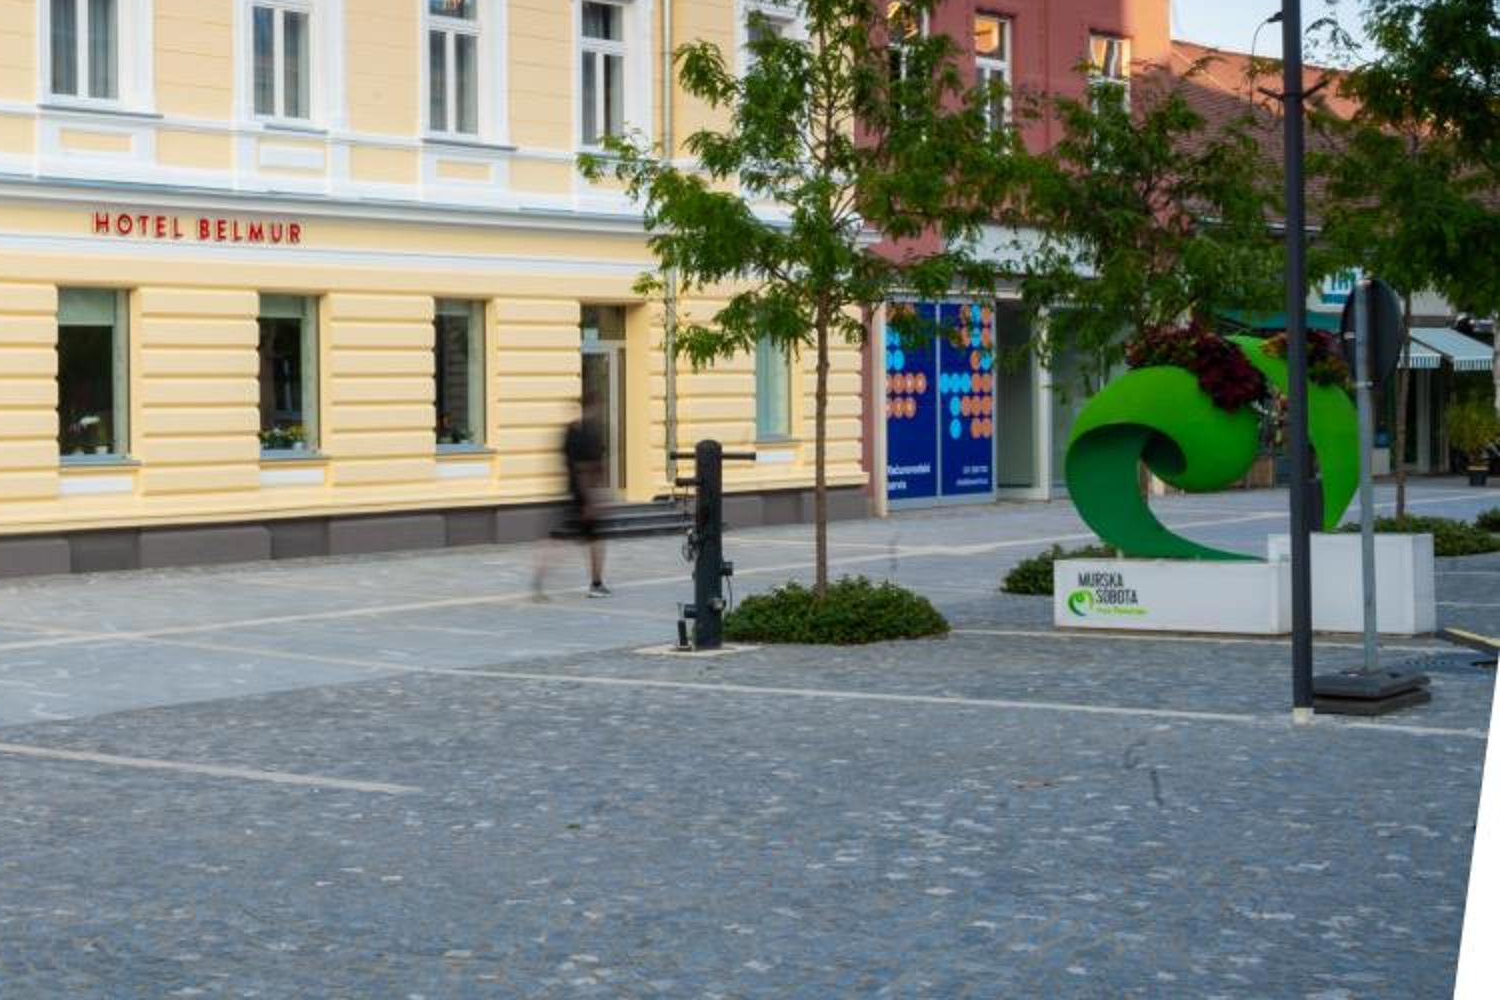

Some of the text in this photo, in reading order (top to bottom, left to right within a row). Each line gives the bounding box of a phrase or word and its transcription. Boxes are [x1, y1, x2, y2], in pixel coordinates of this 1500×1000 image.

[94, 212, 301, 243] HOTEL BELMUR
[1078, 572, 1124, 587] MURSKA
[1095, 589, 1138, 605] SOBOTA
